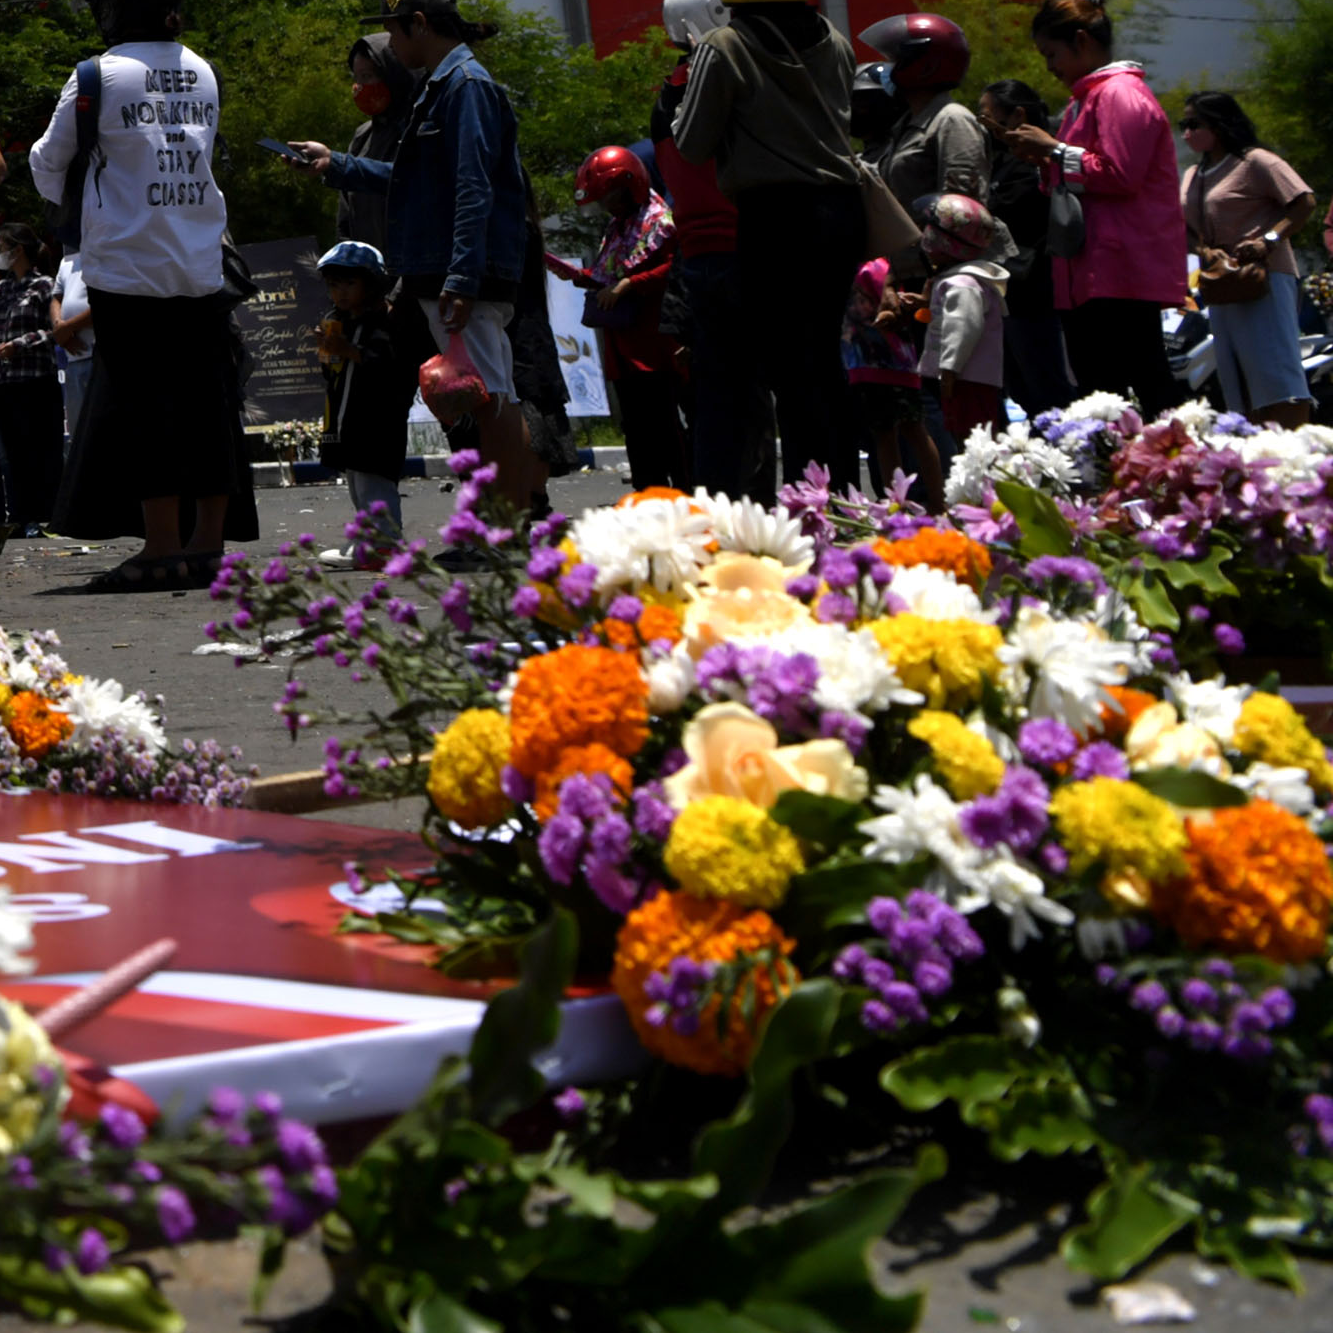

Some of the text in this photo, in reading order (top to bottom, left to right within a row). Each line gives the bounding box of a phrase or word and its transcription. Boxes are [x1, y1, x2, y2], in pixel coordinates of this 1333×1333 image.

[145, 69, 198, 93] KEEP
[165, 129, 186, 143] and
[156, 149, 201, 175] STAY
